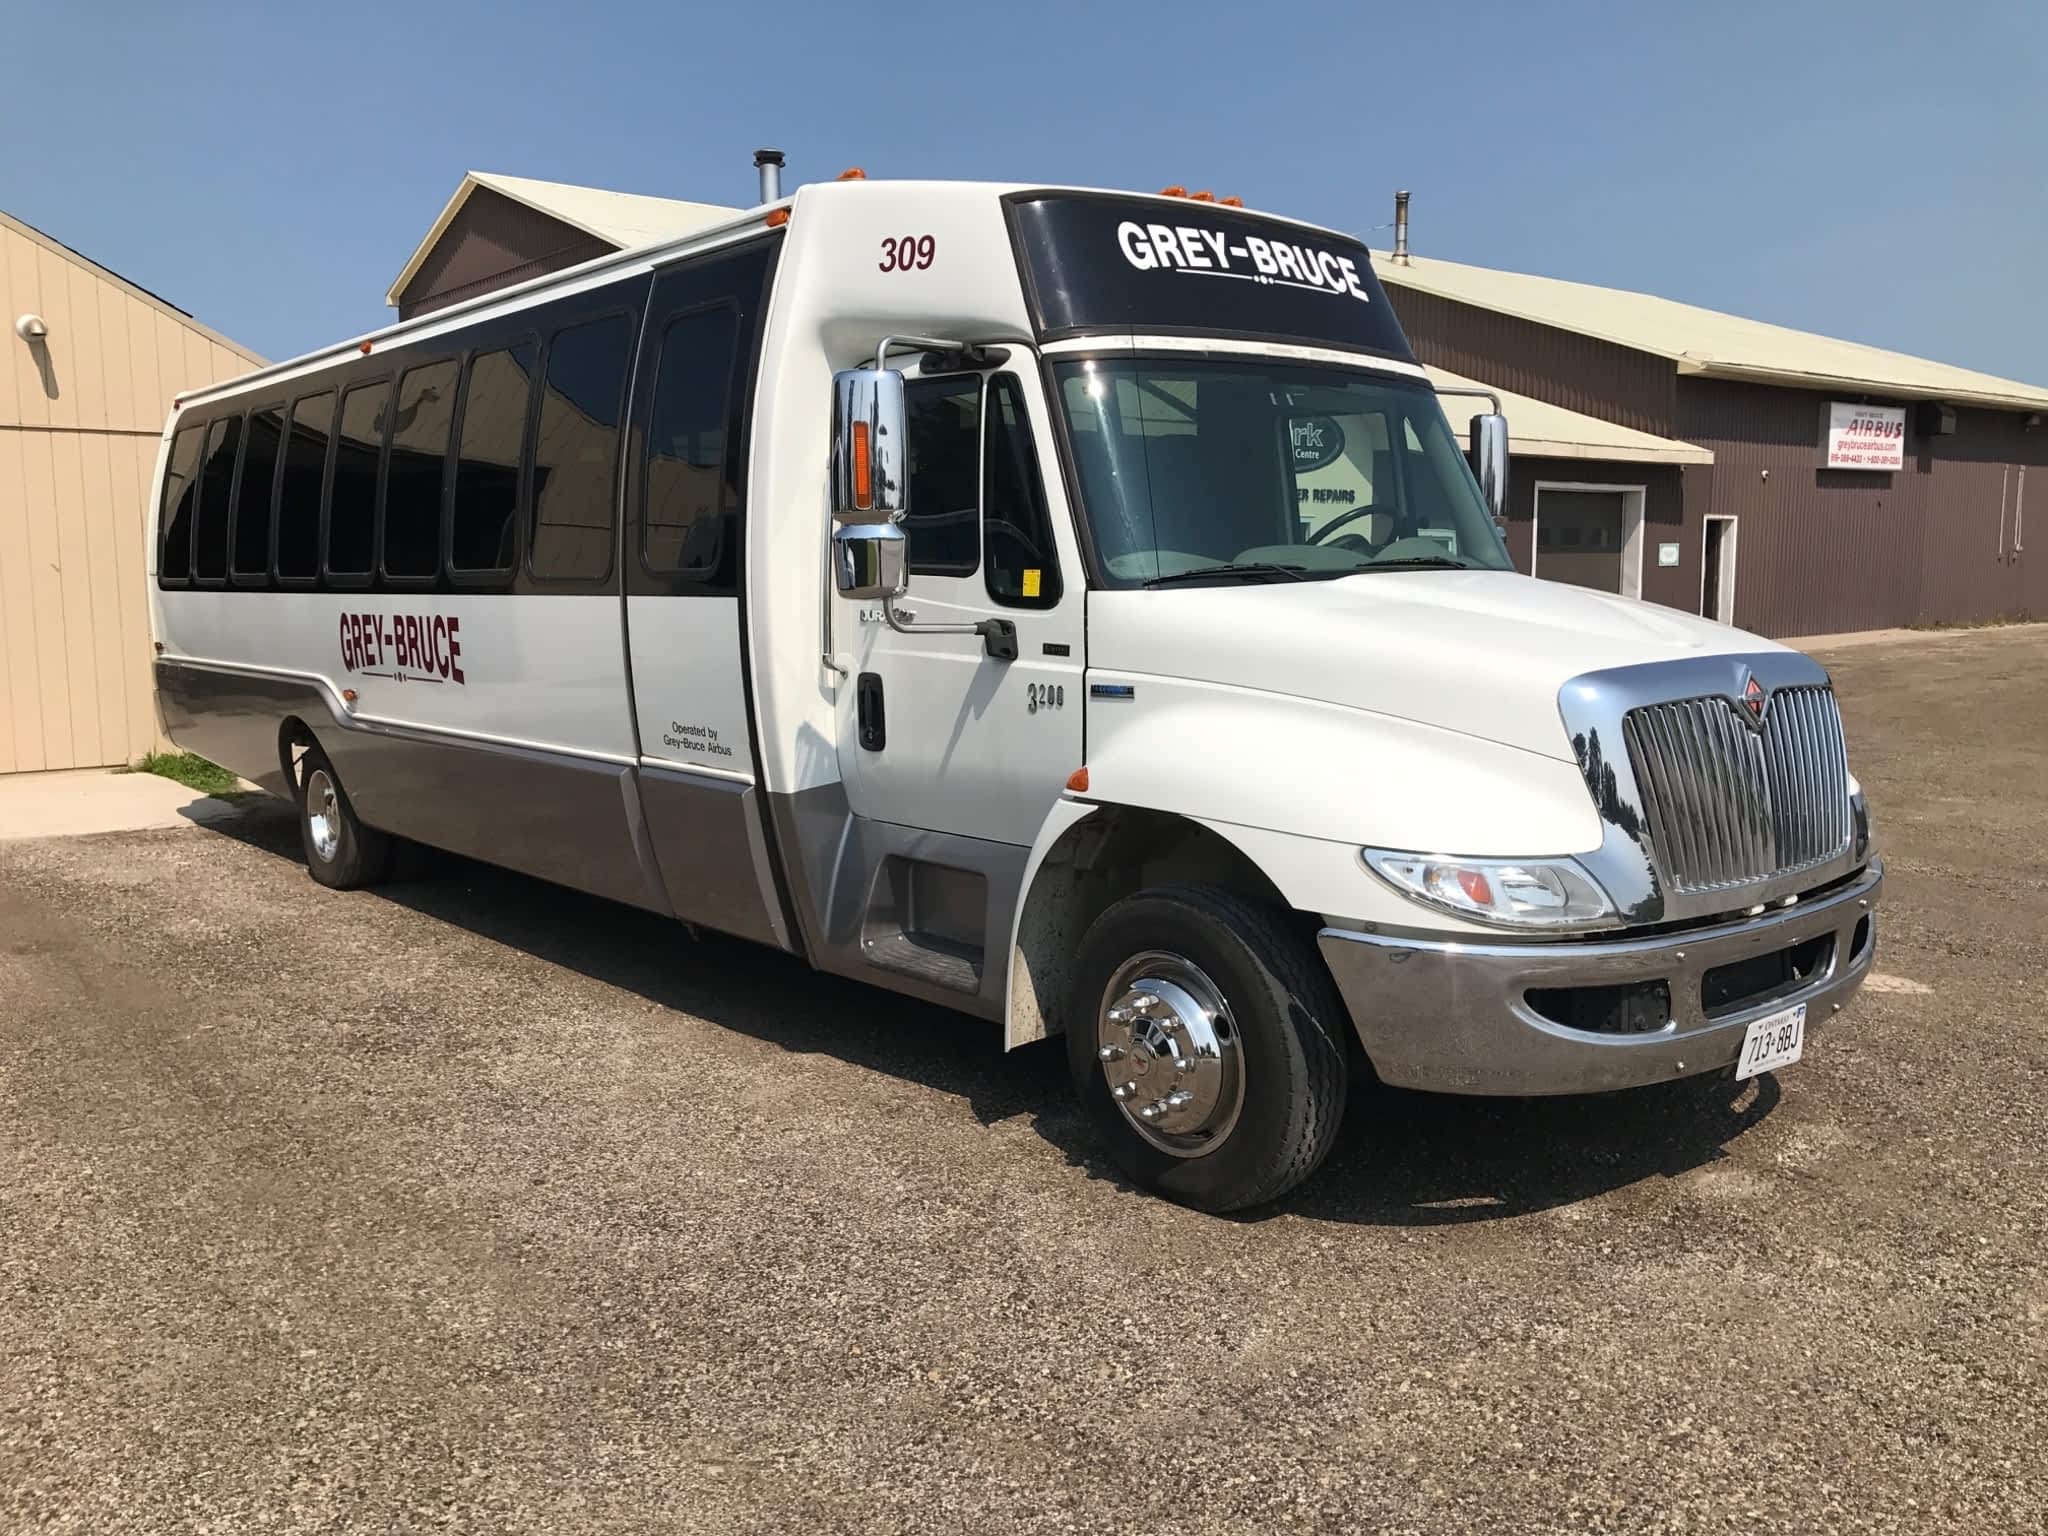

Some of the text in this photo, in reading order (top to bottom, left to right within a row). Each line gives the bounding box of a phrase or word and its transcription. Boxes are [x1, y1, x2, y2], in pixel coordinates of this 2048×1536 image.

[879, 234, 936, 272] 309
[1117, 221, 1370, 302] GREY-BRUCE
[1846, 418, 1903, 439] AIRBUS
[1295, 448, 1320, 460] Centre
[1312, 488, 1356, 505] REPAIRS
[340, 612, 465, 686] GREY-BRUCE
[1027, 682, 1064, 714] 3200
[671, 721, 718, 741] Operated by
[663, 734, 732, 756] Grey-Bruce Airbus
